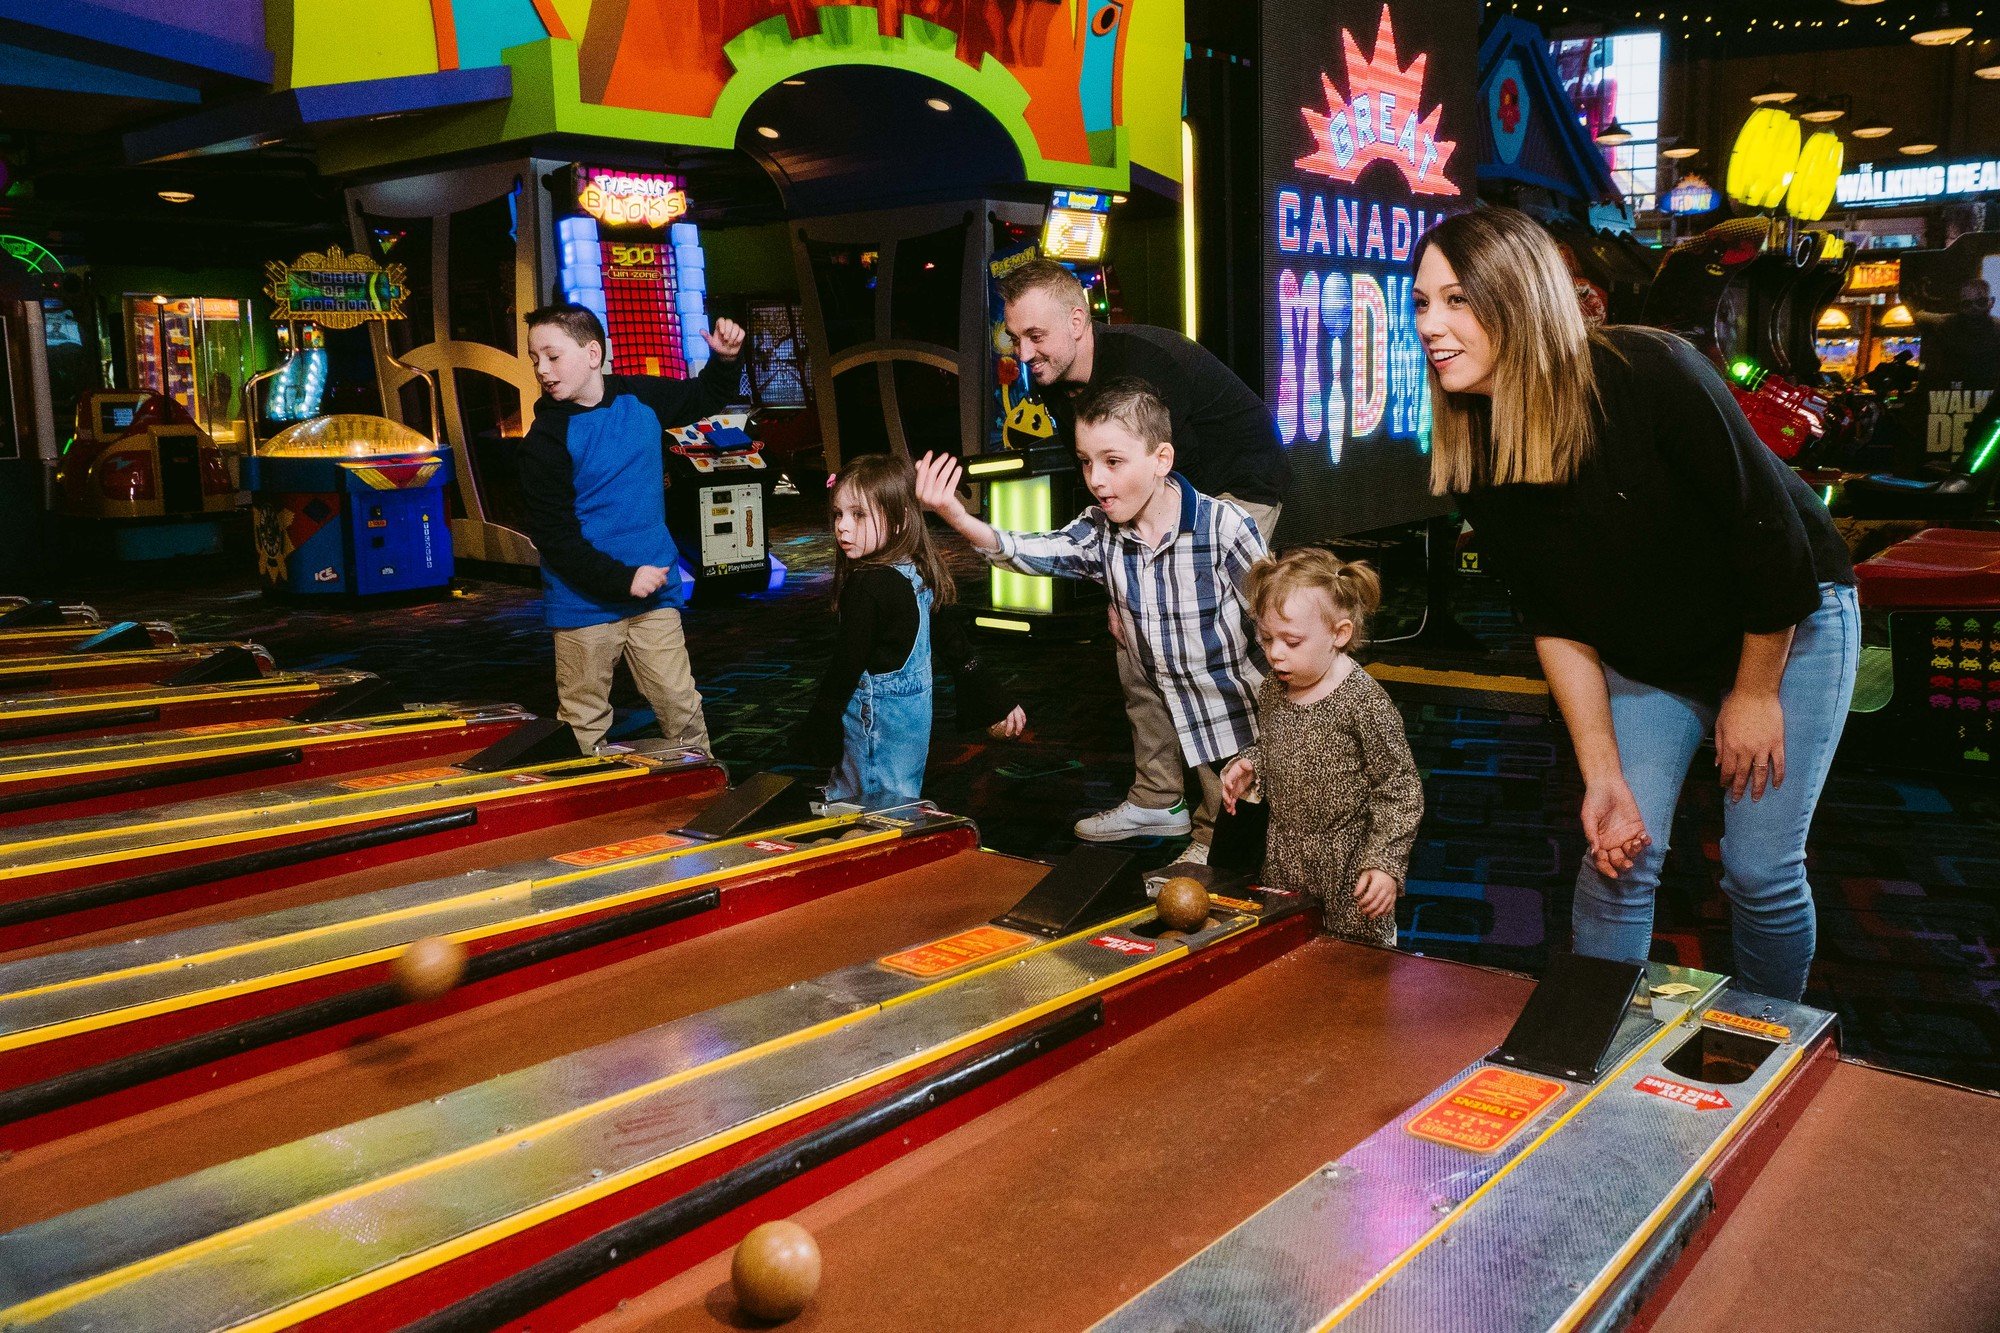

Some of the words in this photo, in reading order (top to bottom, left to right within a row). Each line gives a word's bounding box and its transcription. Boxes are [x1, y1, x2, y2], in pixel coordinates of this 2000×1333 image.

[1329, 92, 1438, 182] GREAT
[1860, 163, 1873, 173] THE
[1836, 166, 1945, 203] WALKING
[1946, 161, 2000, 194] DEA
[585, 189, 682, 221] BLOKS
[612, 246, 654, 266] 500
[311, 271, 366, 284] WHEEL
[612, 270, 629, 278] WIN
[631, 270, 658, 279] ZONE
[324, 286, 345, 298] OF
[1928, 390, 1994, 413] WALK
[1926, 413, 1974, 453] DE
[314, 566, 338, 581] ICE
[1711, 1012, 1769, 1031] TOKENS
[1643, 1077, 1685, 1094] LANE
[1658, 1089, 1699, 1105] PLAY
[1686, 1089, 1725, 1106] THIS
[1453, 1096, 1507, 1116] TOKENS
[1509, 1111, 1523, 1120] 2
